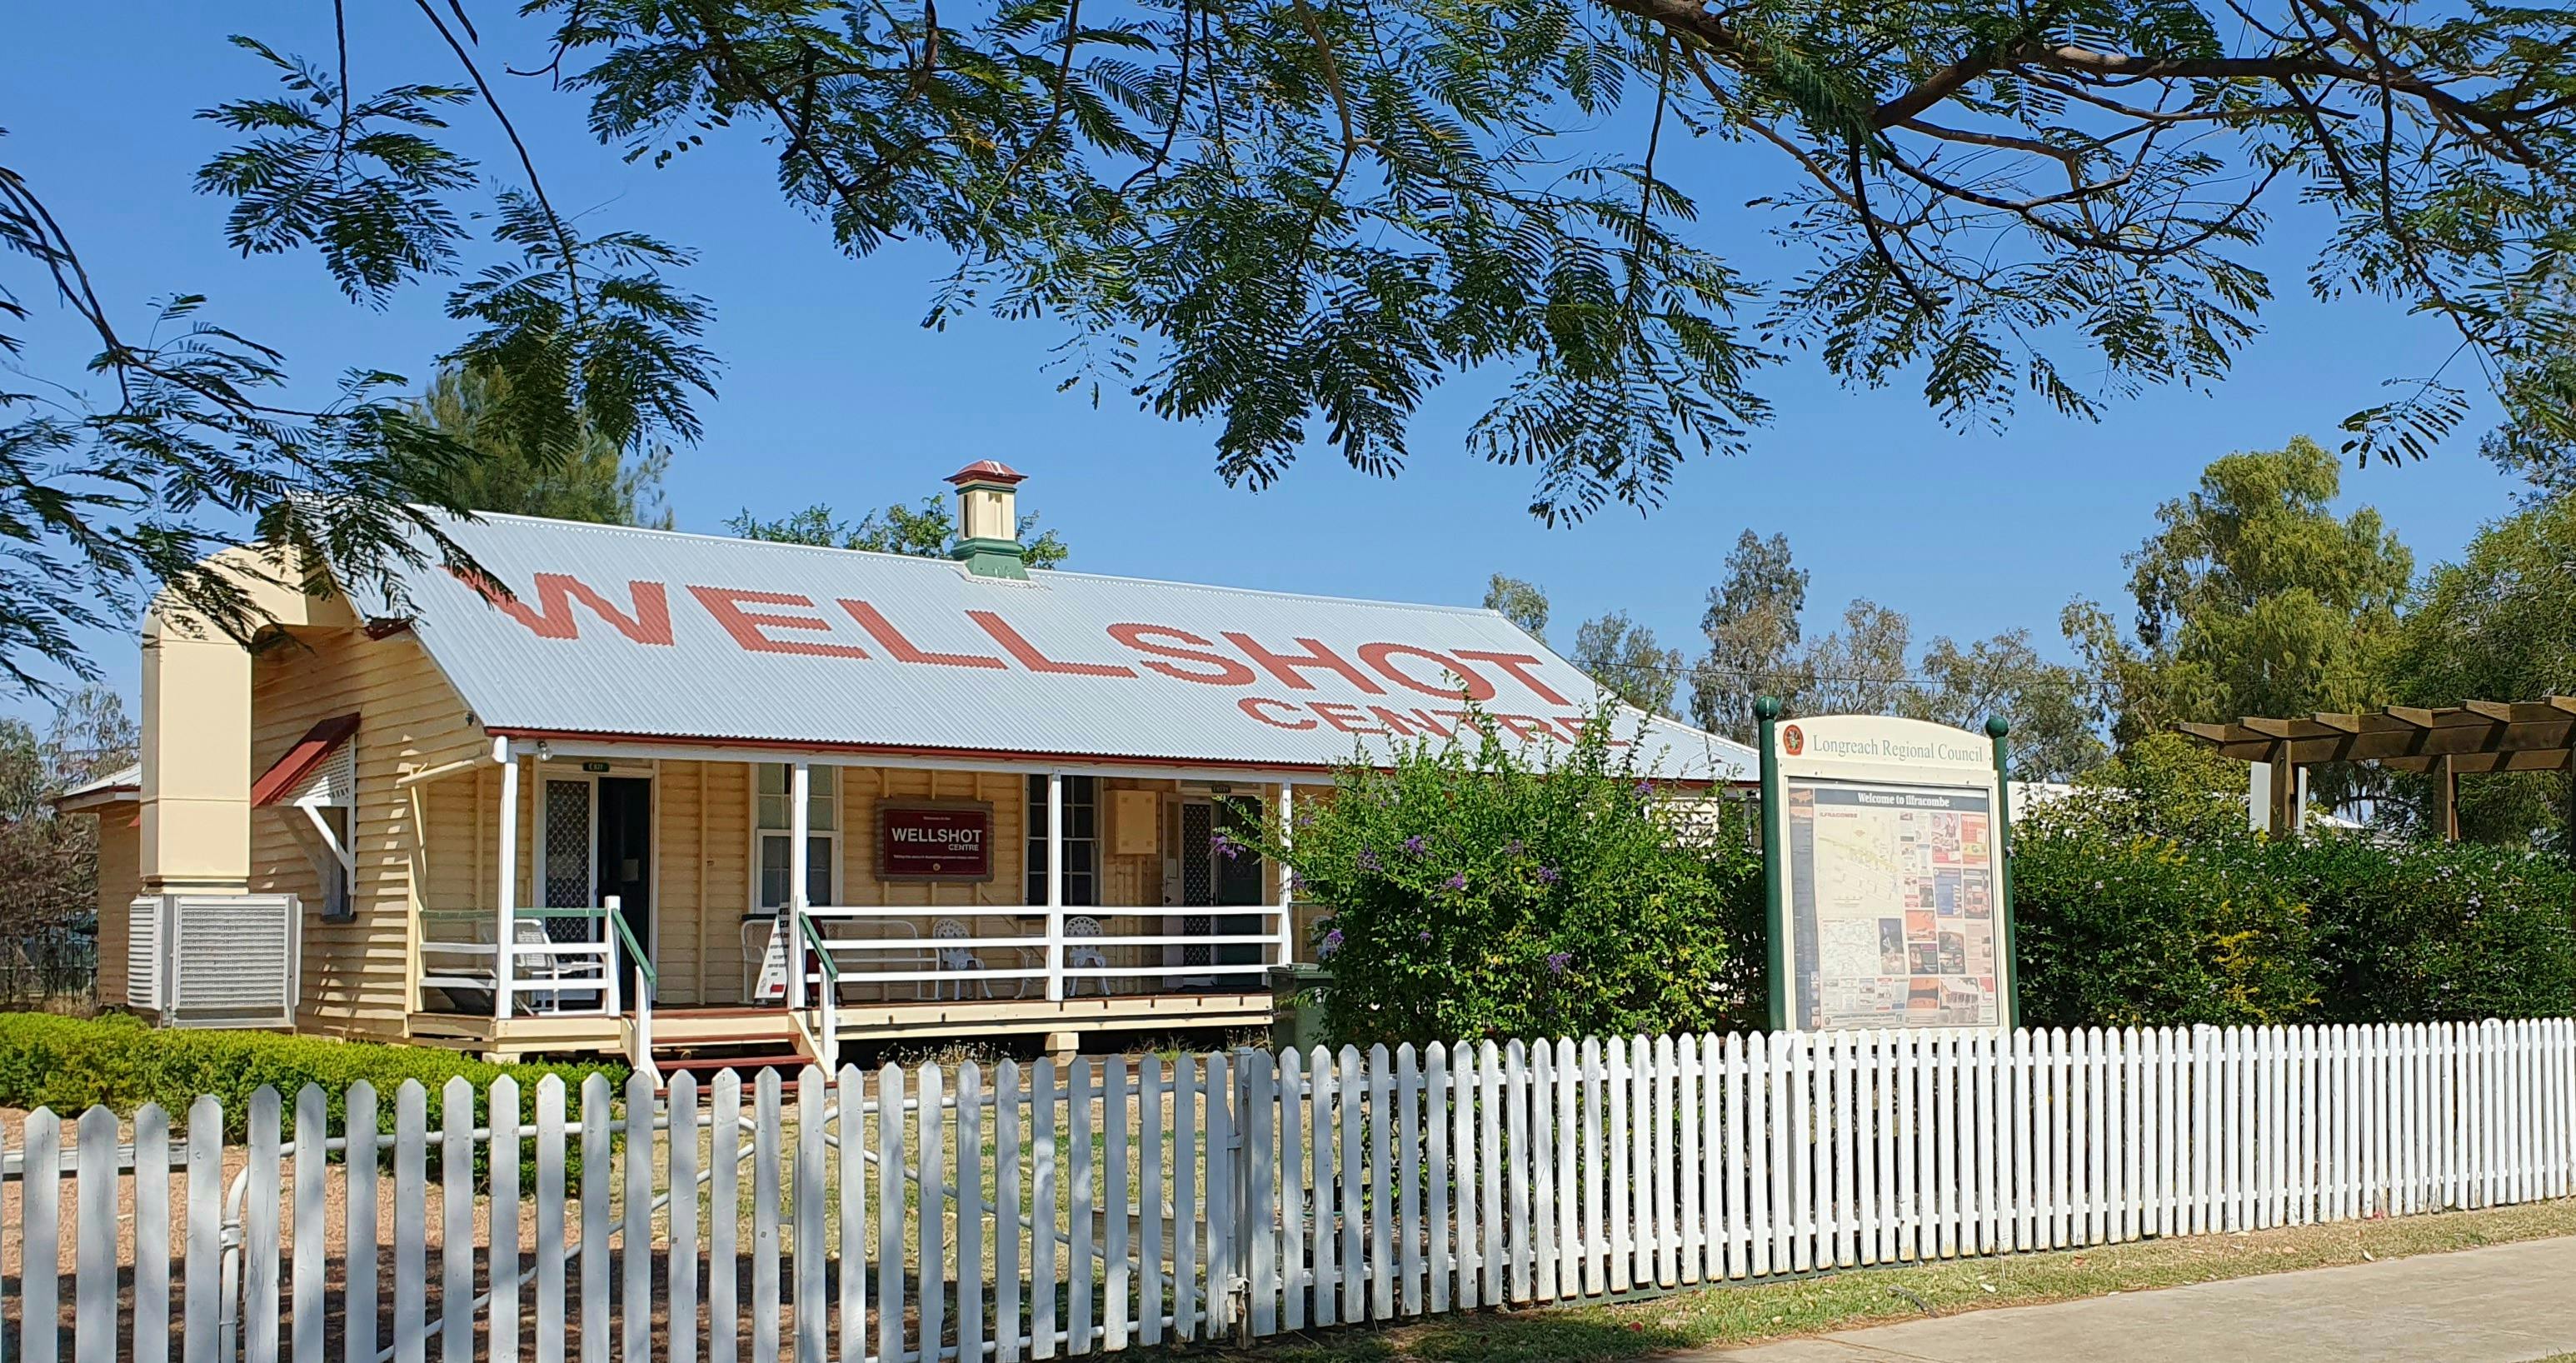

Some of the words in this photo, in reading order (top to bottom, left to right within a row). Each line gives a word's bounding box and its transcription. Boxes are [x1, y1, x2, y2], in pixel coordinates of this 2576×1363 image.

[436, 563, 1573, 706] WELLSHOT
[1813, 735, 1878, 756] Longreach
[1882, 740, 1934, 761] Regional
[1938, 743, 1984, 762] Council
[1857, 792, 1895, 805] Welcome
[1895, 795, 1905, 805] to
[1905, 795, 1950, 807] Ilfracombe
[891, 828, 982, 843] WELLSHOT
